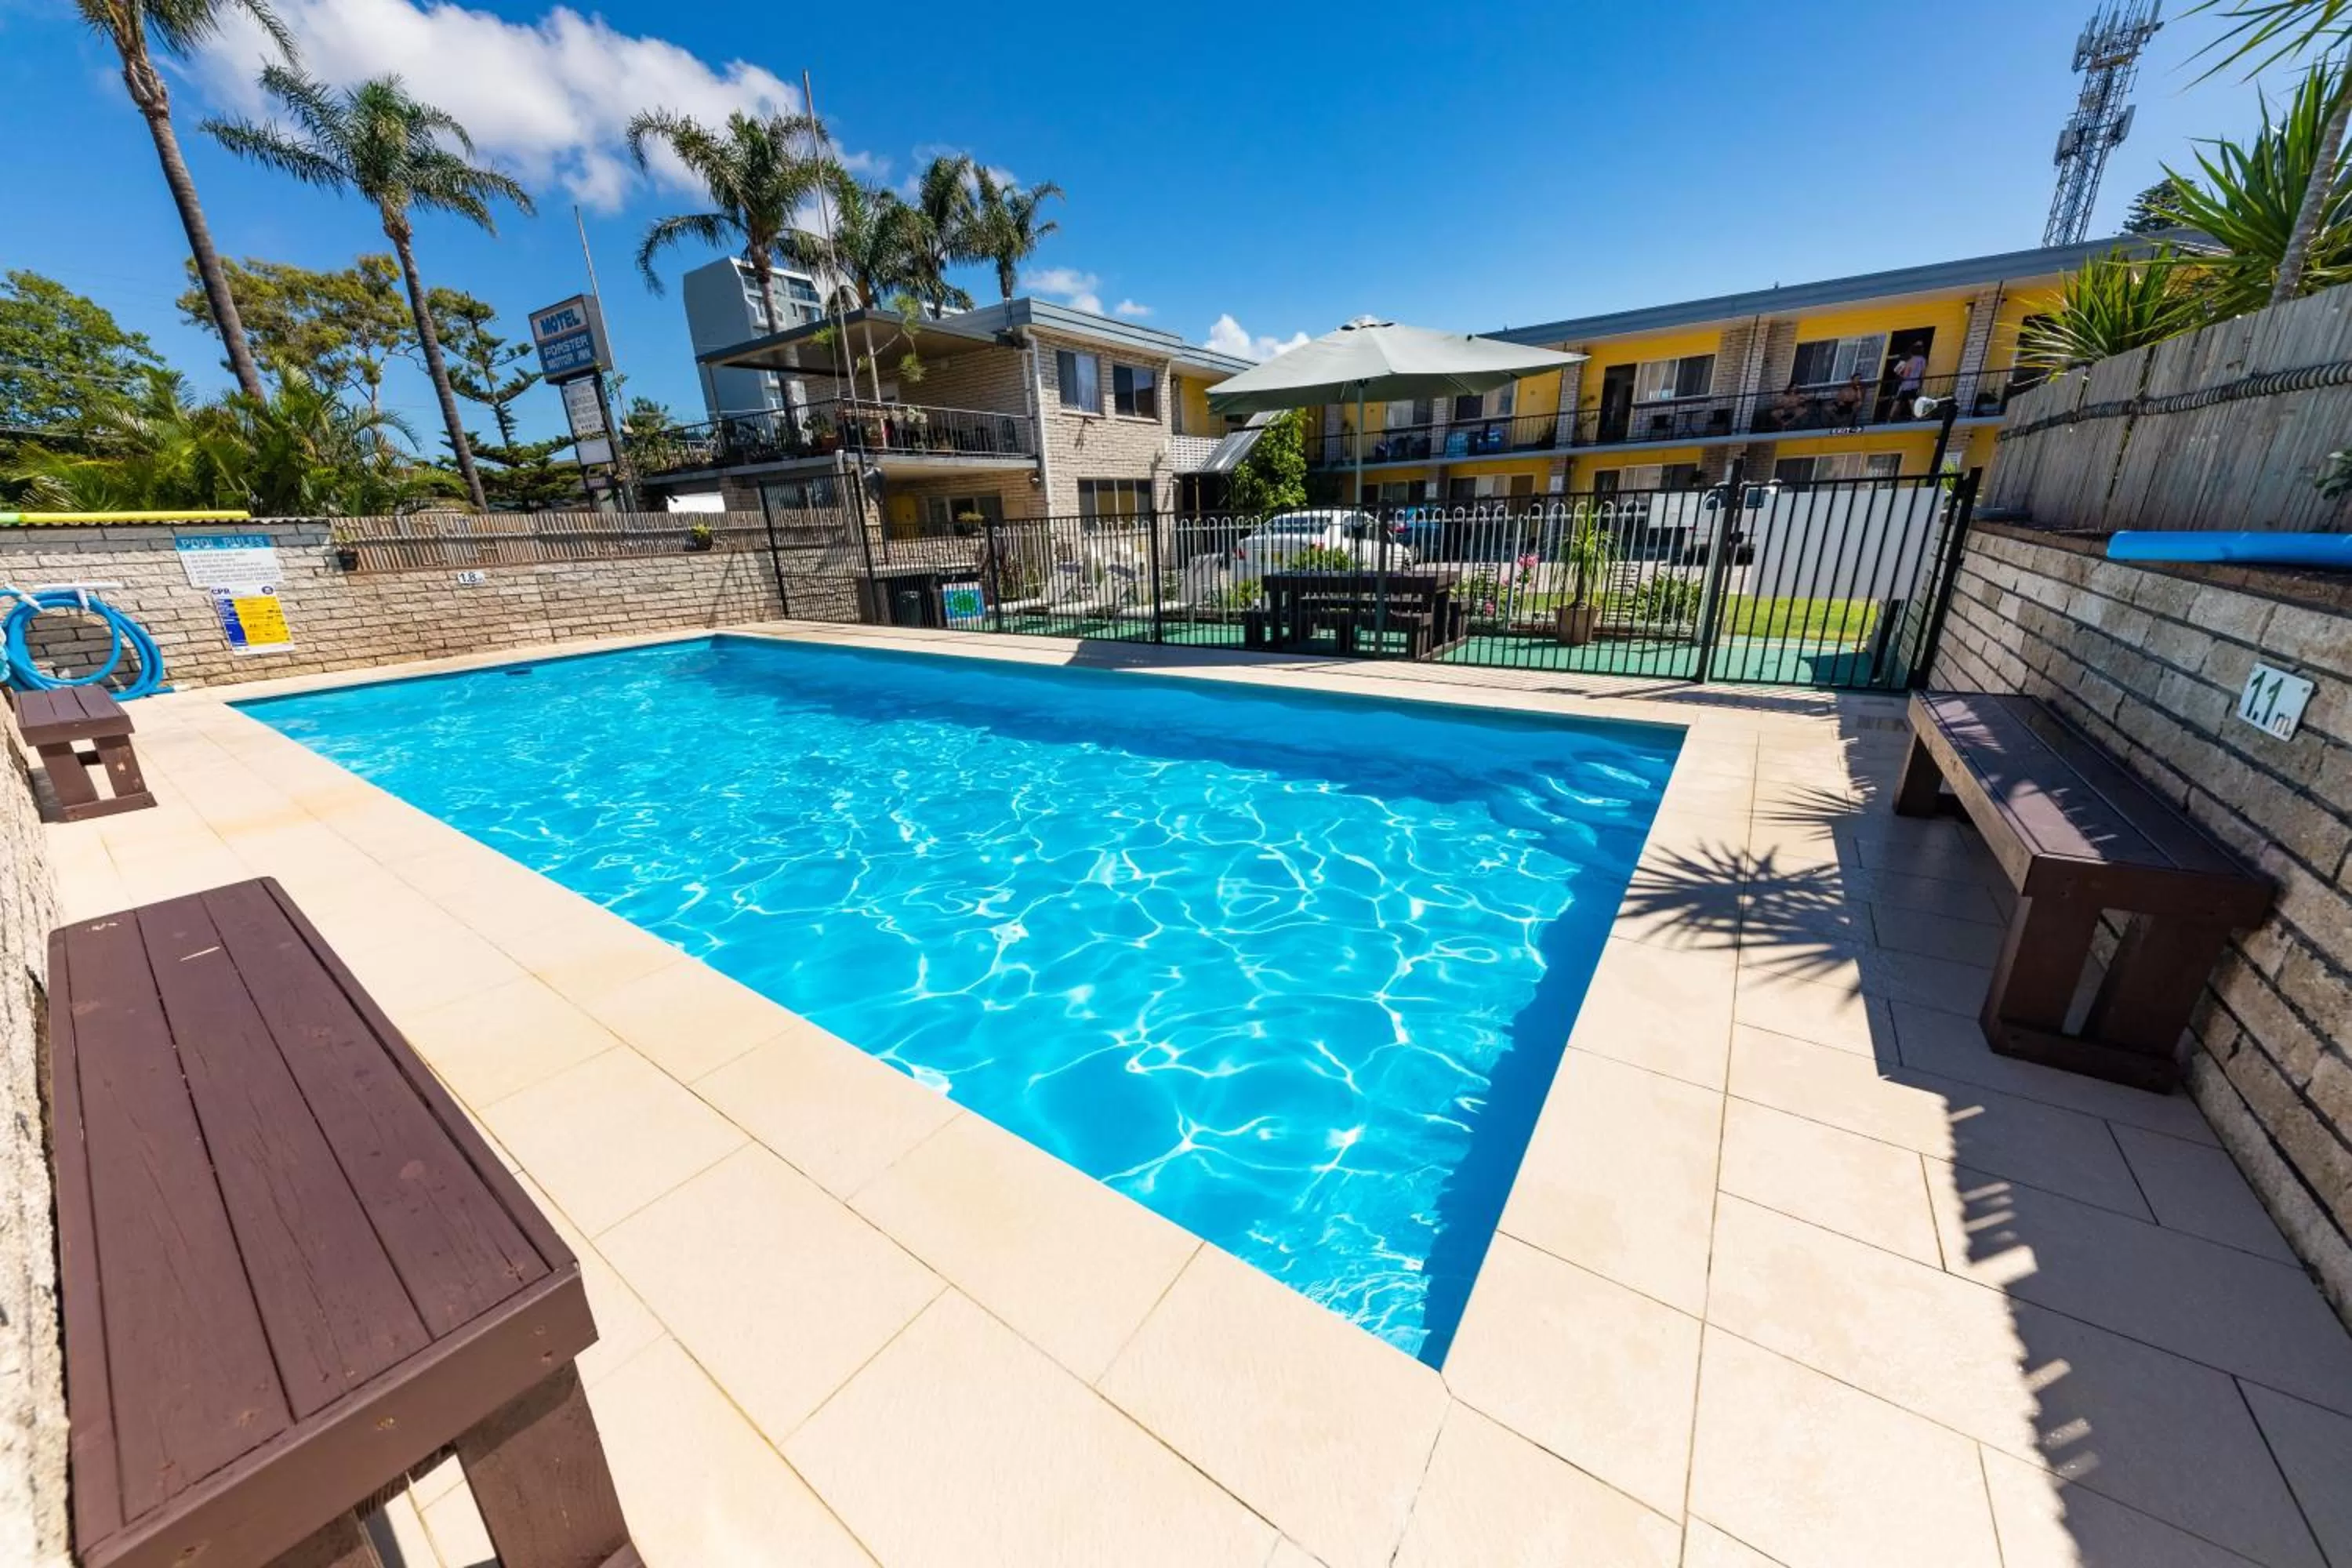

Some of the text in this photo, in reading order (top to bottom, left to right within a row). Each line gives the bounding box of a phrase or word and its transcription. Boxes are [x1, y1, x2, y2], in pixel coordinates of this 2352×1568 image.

[539, 308, 580, 336] MOTEL
[544, 335, 589, 358] FORSTER
[180, 535, 265, 549] POOL RULES
